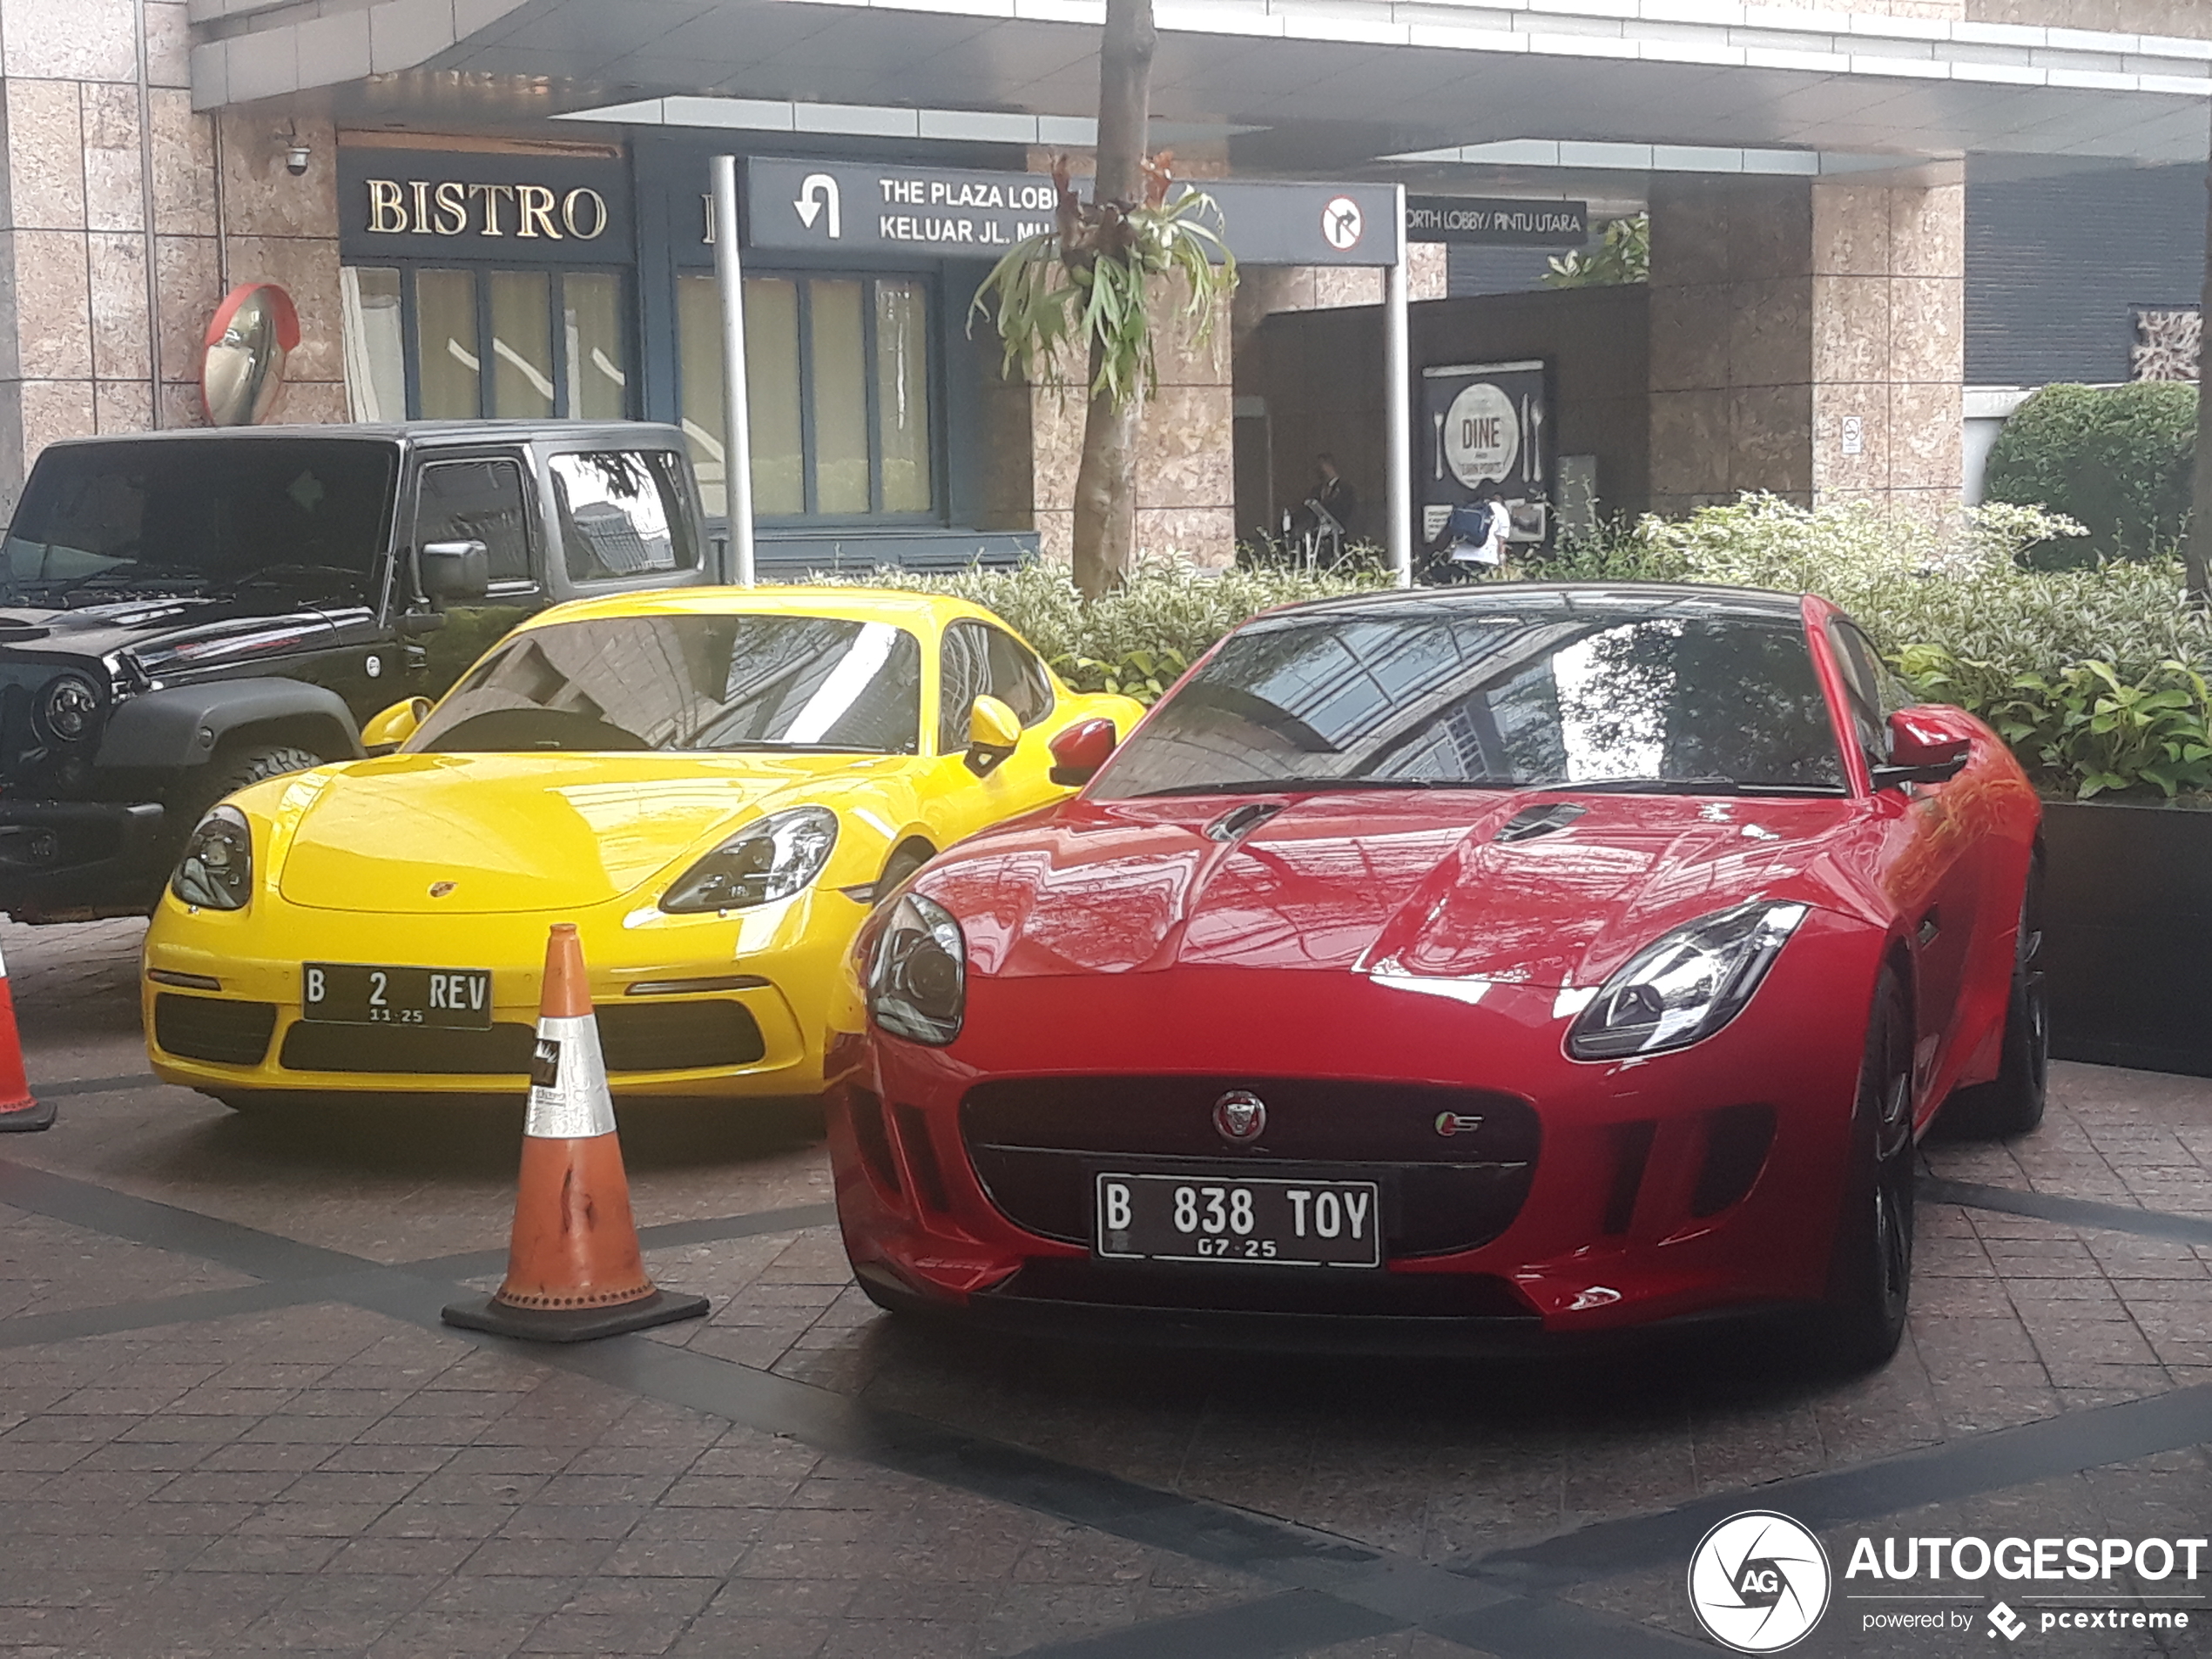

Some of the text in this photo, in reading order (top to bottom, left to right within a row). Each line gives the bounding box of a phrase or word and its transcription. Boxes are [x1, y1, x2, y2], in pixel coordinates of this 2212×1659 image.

[880, 179, 925, 205] THE
[931, 182, 1003, 208] PLAZA
[366, 179, 608, 239] BISTRO
[1405, 209, 1441, 228] ORTH
[1494, 212, 1533, 232] PINTU
[1535, 213, 1581, 232] UTARA
[880, 216, 974, 243] KELUAR
[979, 220, 1011, 244] JL.
[1462, 418, 1501, 448] DINE
[307, 968, 486, 1009] B 2 REV
[1107, 1184, 1368, 1238] B 838 TOY
